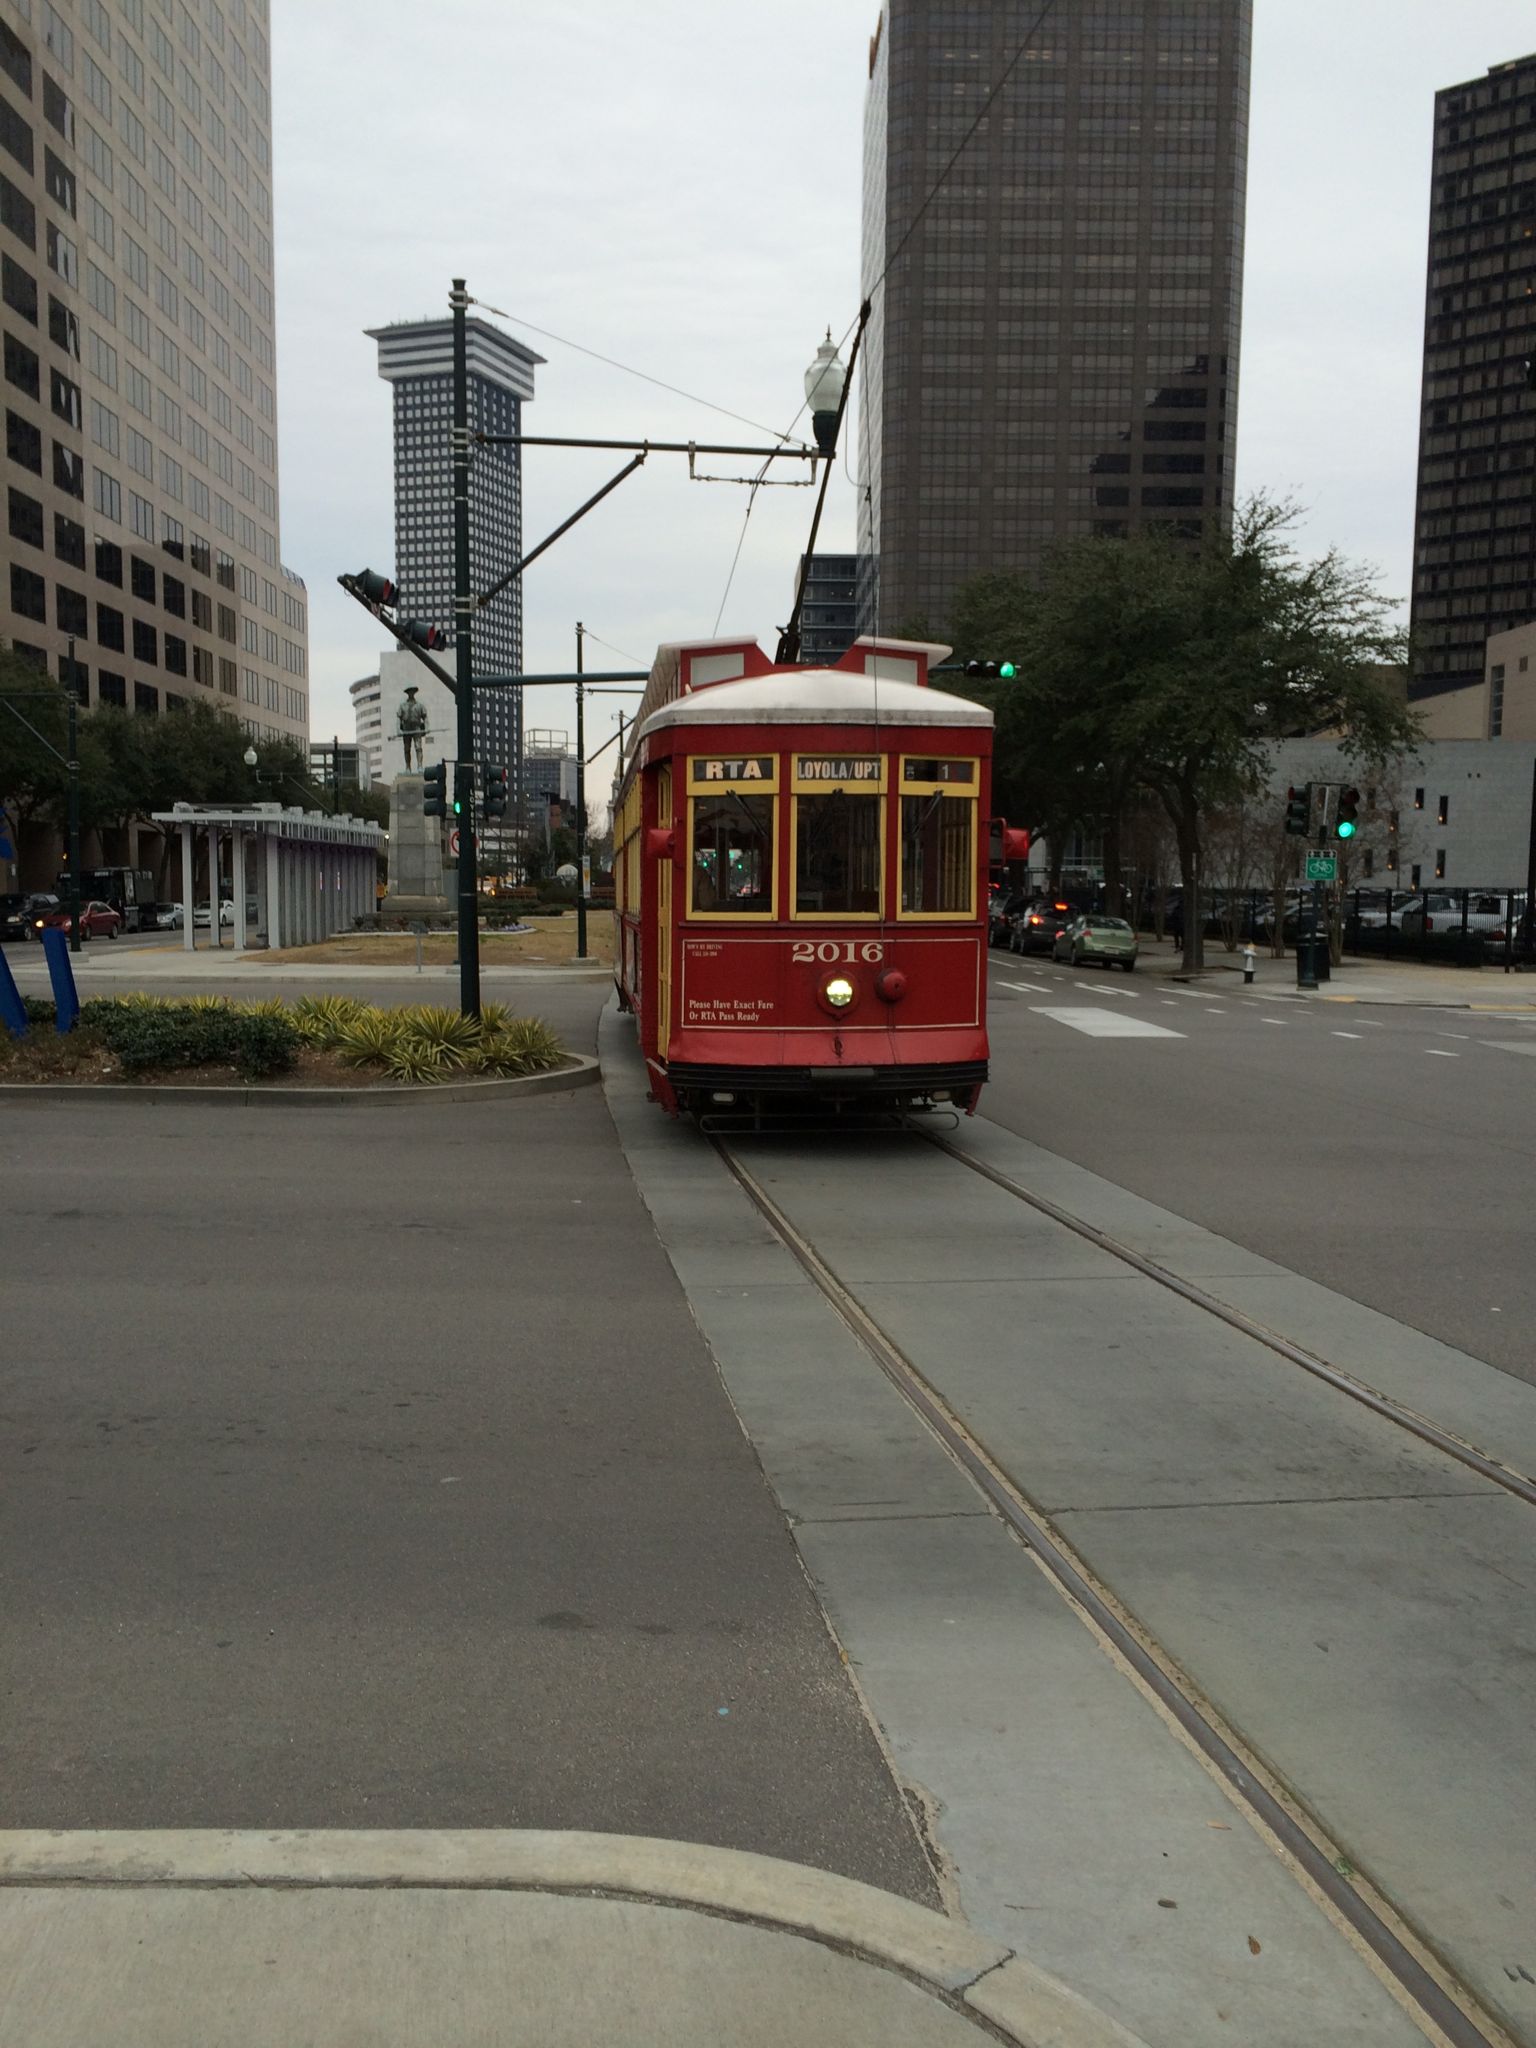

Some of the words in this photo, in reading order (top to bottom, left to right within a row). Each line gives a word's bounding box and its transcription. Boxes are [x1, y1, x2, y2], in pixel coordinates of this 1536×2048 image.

[706, 760, 762, 780] RTA
[798, 761, 880, 779] LOYOLA/UPT
[792, 942, 884, 963] 2016
[689, 999, 711, 1009] Please
[713, 999, 731, 1009] Have
[734, 1000, 755, 1009] Exact
[758, 1000, 774, 1009] Fare
[689, 1011, 699, 1020] Or
[701, 1011, 717, 1020] RTA
[719, 1011, 735, 1020] Pass
[737, 1011, 760, 1022] Ready
